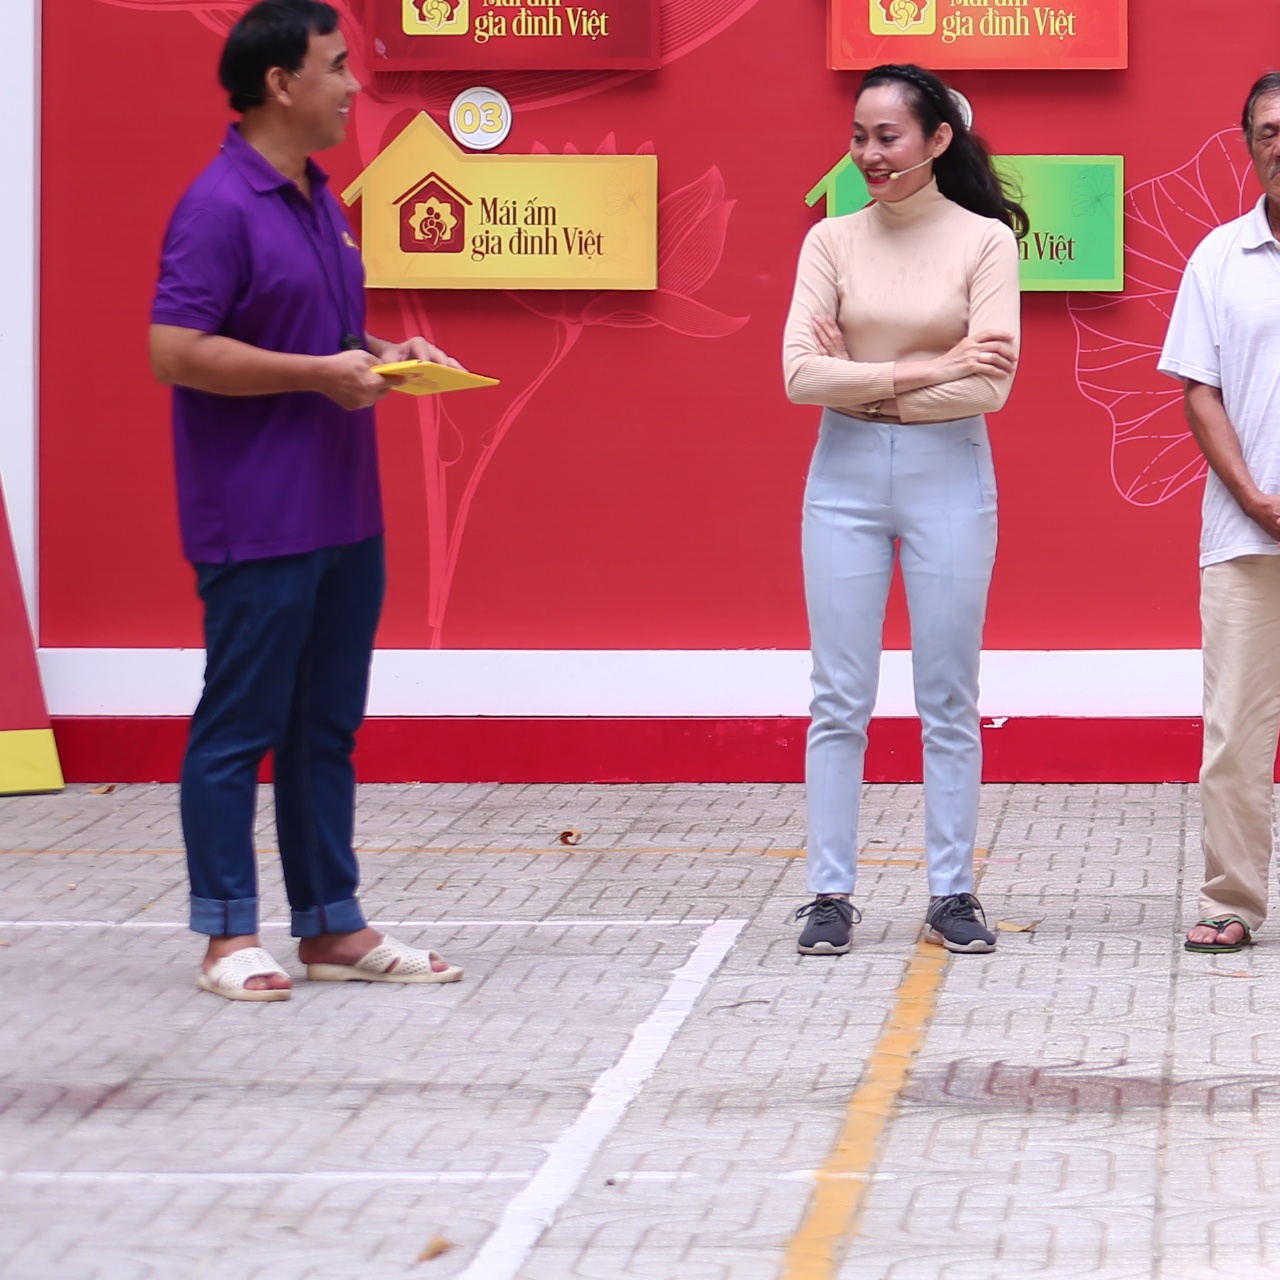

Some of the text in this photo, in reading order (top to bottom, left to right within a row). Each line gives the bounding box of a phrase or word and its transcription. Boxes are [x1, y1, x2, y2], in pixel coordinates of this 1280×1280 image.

[474, 7, 609, 44] gia đình Việt
[941, 7, 1076, 44] gia đình Việt
[456, 101, 504, 134] 03
[479, 196, 557, 226] Mái ấm
[471, 227, 605, 262] gia đình Việt
[1032, 231, 1076, 265] Việt
